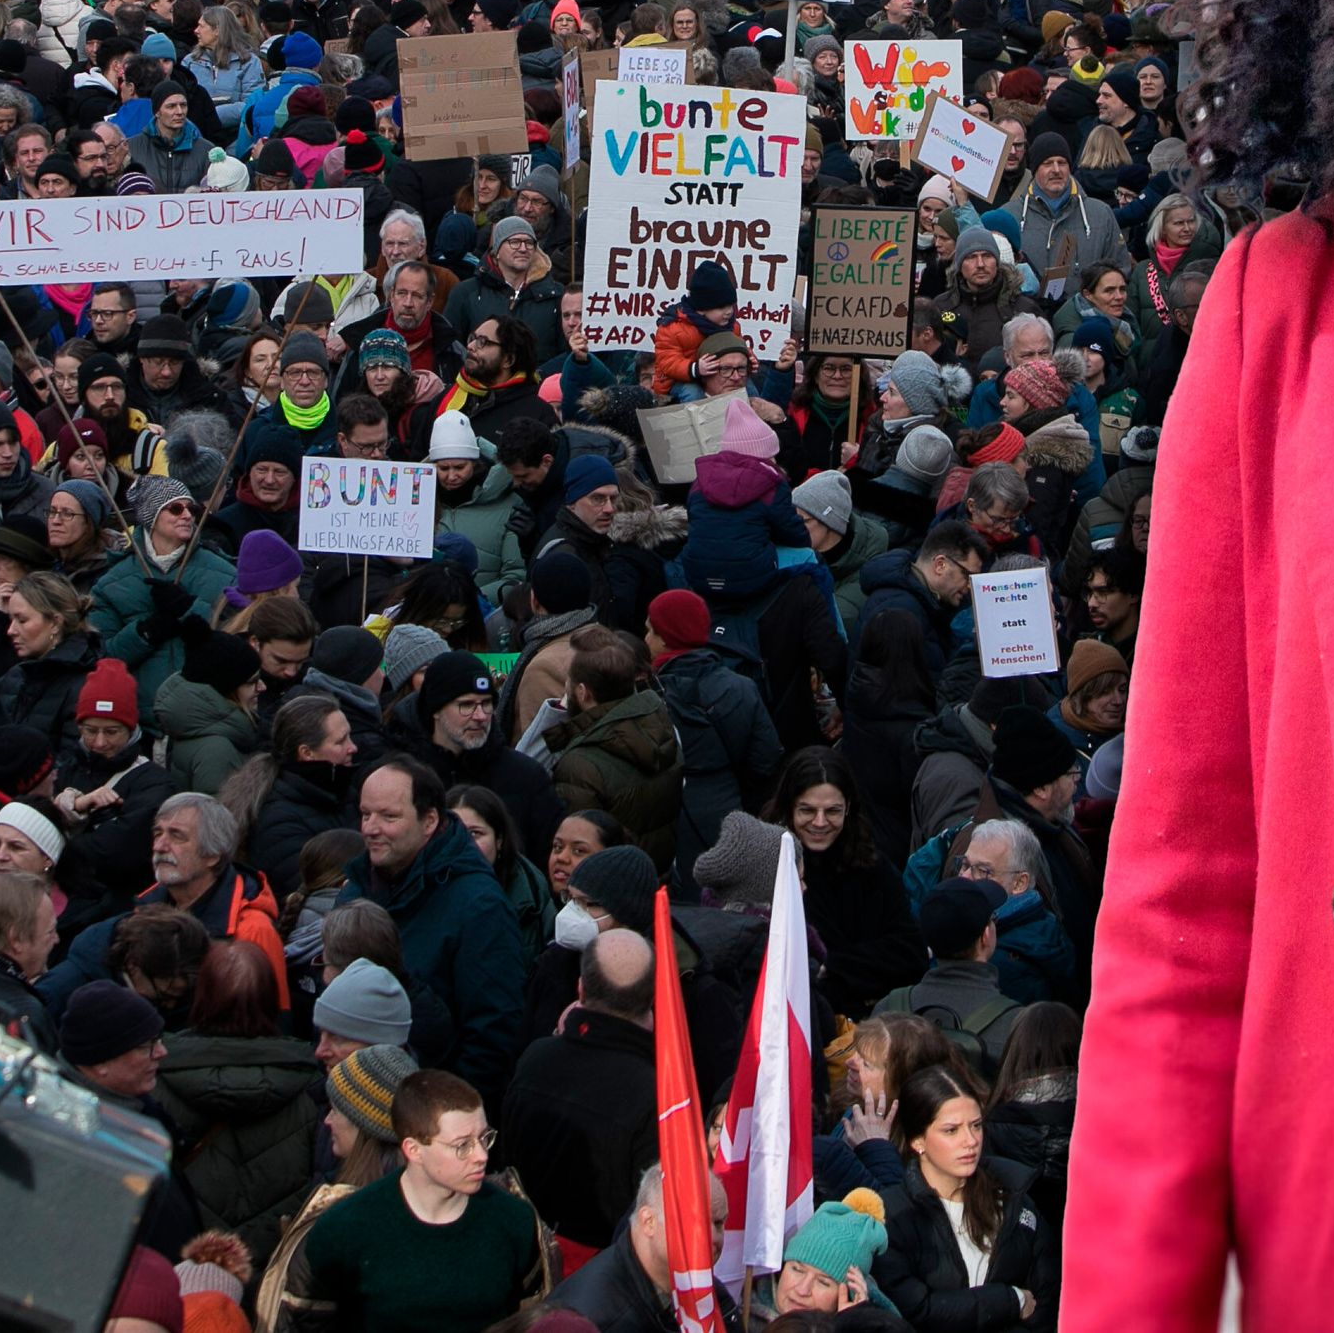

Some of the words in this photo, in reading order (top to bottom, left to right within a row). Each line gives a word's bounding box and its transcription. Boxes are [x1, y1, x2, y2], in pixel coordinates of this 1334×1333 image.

[629, 57, 659, 72] LEBE
[663, 59, 679, 72] SO
[853, 42, 951, 91] Wir
[639, 85, 768, 131] bunte
[605, 129, 800, 178] VIELFALT
[930, 127, 994, 167] #DeutschlandIstBunt!
[664, 182, 744, 207] STATT
[630, 206, 771, 250] braune
[816, 216, 909, 243] LIBERTÉ
[236, 237, 307, 273] RAUS!
[814, 258, 905, 286] EGALITÉ
[735, 301, 791, 325] ehrheit
[584, 324, 646, 345] #AfD
[811, 327, 905, 348] #NAZISRAUS
[307, 462, 433, 509] BUNT
[330, 512, 351, 527] IST
[359, 512, 399, 528] MEINE
[304, 531, 422, 554] LIEBLINGSFARBE
[982, 582, 1038, 593] Menschen-
[995, 593, 1028, 603] rechte
[1002, 619, 1027, 628] statt
[991, 652, 1046, 665] Menschen!
[1001, 644, 1034, 654] rechte
